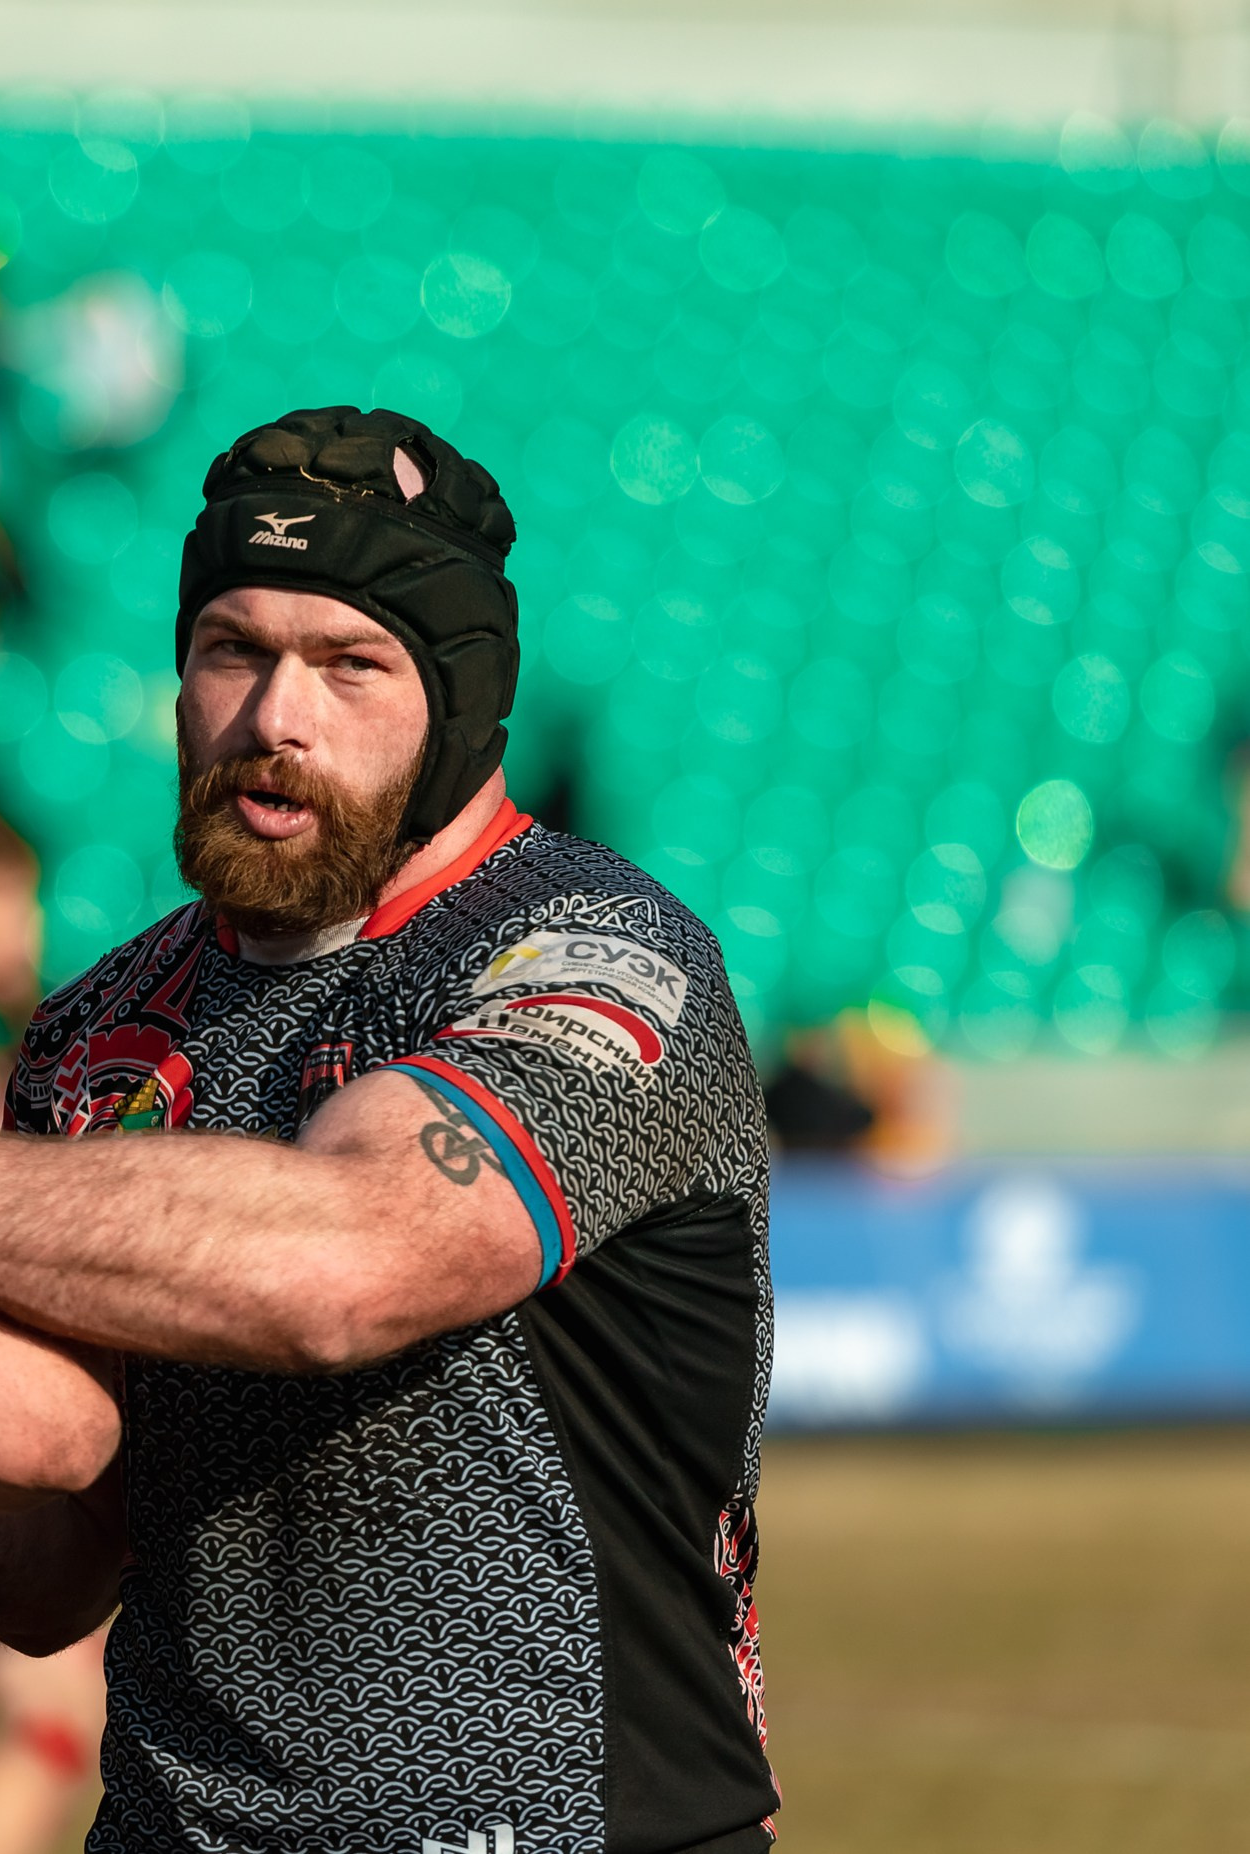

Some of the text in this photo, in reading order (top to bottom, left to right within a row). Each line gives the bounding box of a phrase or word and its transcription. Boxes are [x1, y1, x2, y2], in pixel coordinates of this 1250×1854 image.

[248, 531, 308, 550] MIZUNO
[561, 961, 616, 974] СИБИРСКАЯ
[565, 941, 681, 999] СУЭК
